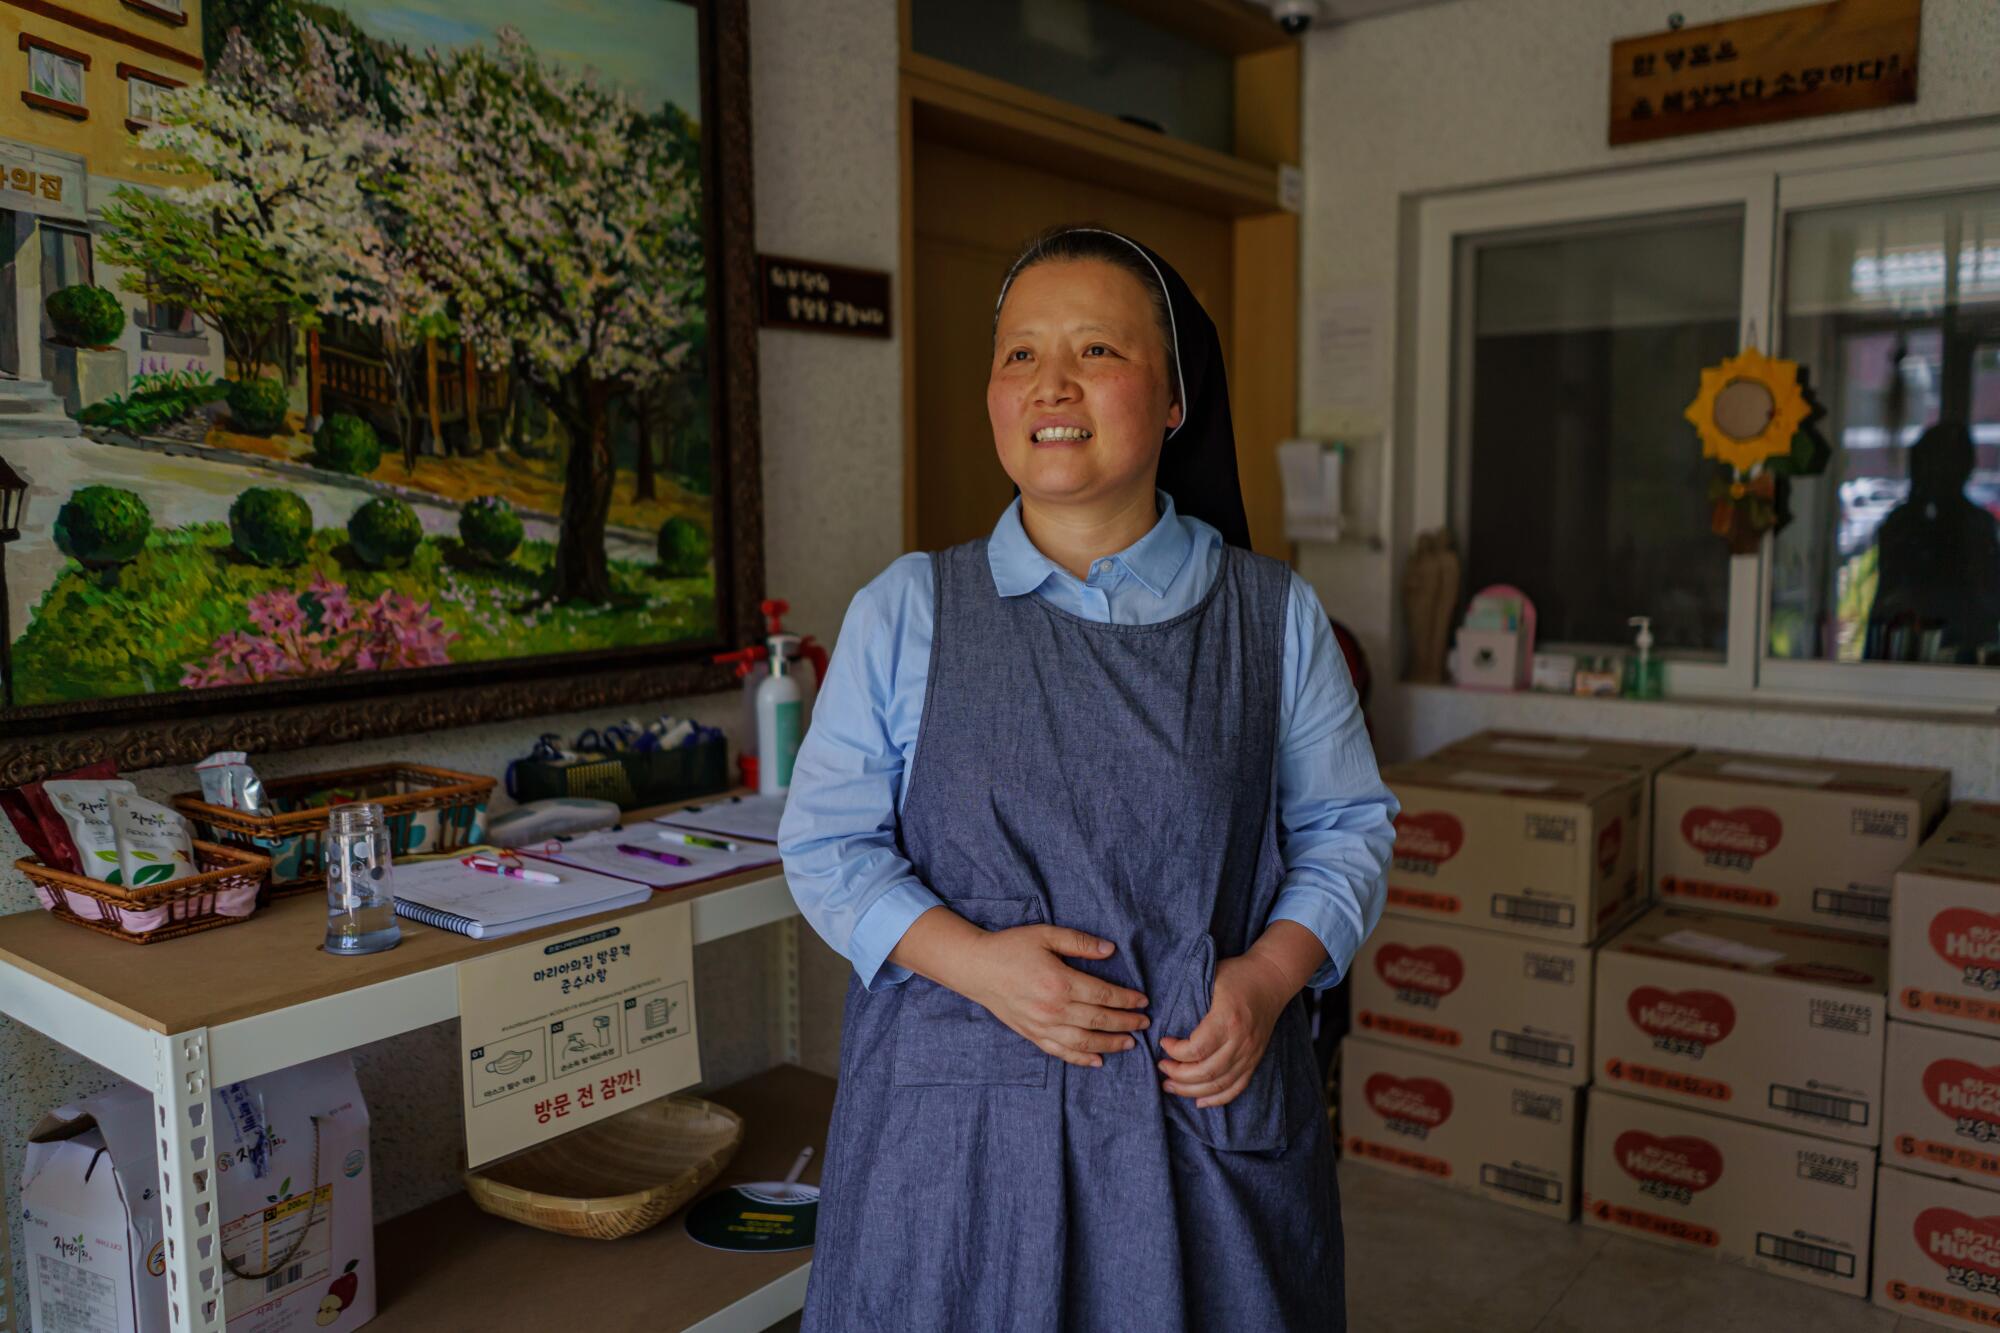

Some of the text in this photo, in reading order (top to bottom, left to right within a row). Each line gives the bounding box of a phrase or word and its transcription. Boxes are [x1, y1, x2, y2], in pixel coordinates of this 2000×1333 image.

[533, 944, 631, 982] 마리아의집 방문객
[561, 969, 607, 995] 준수사항
[1609, 1061, 1622, 1079] 4
[534, 1068, 642, 1124] 방문 전 잠깐!
[1902, 1136, 1915, 1154] 5
[1894, 1283, 1906, 1300] 5
